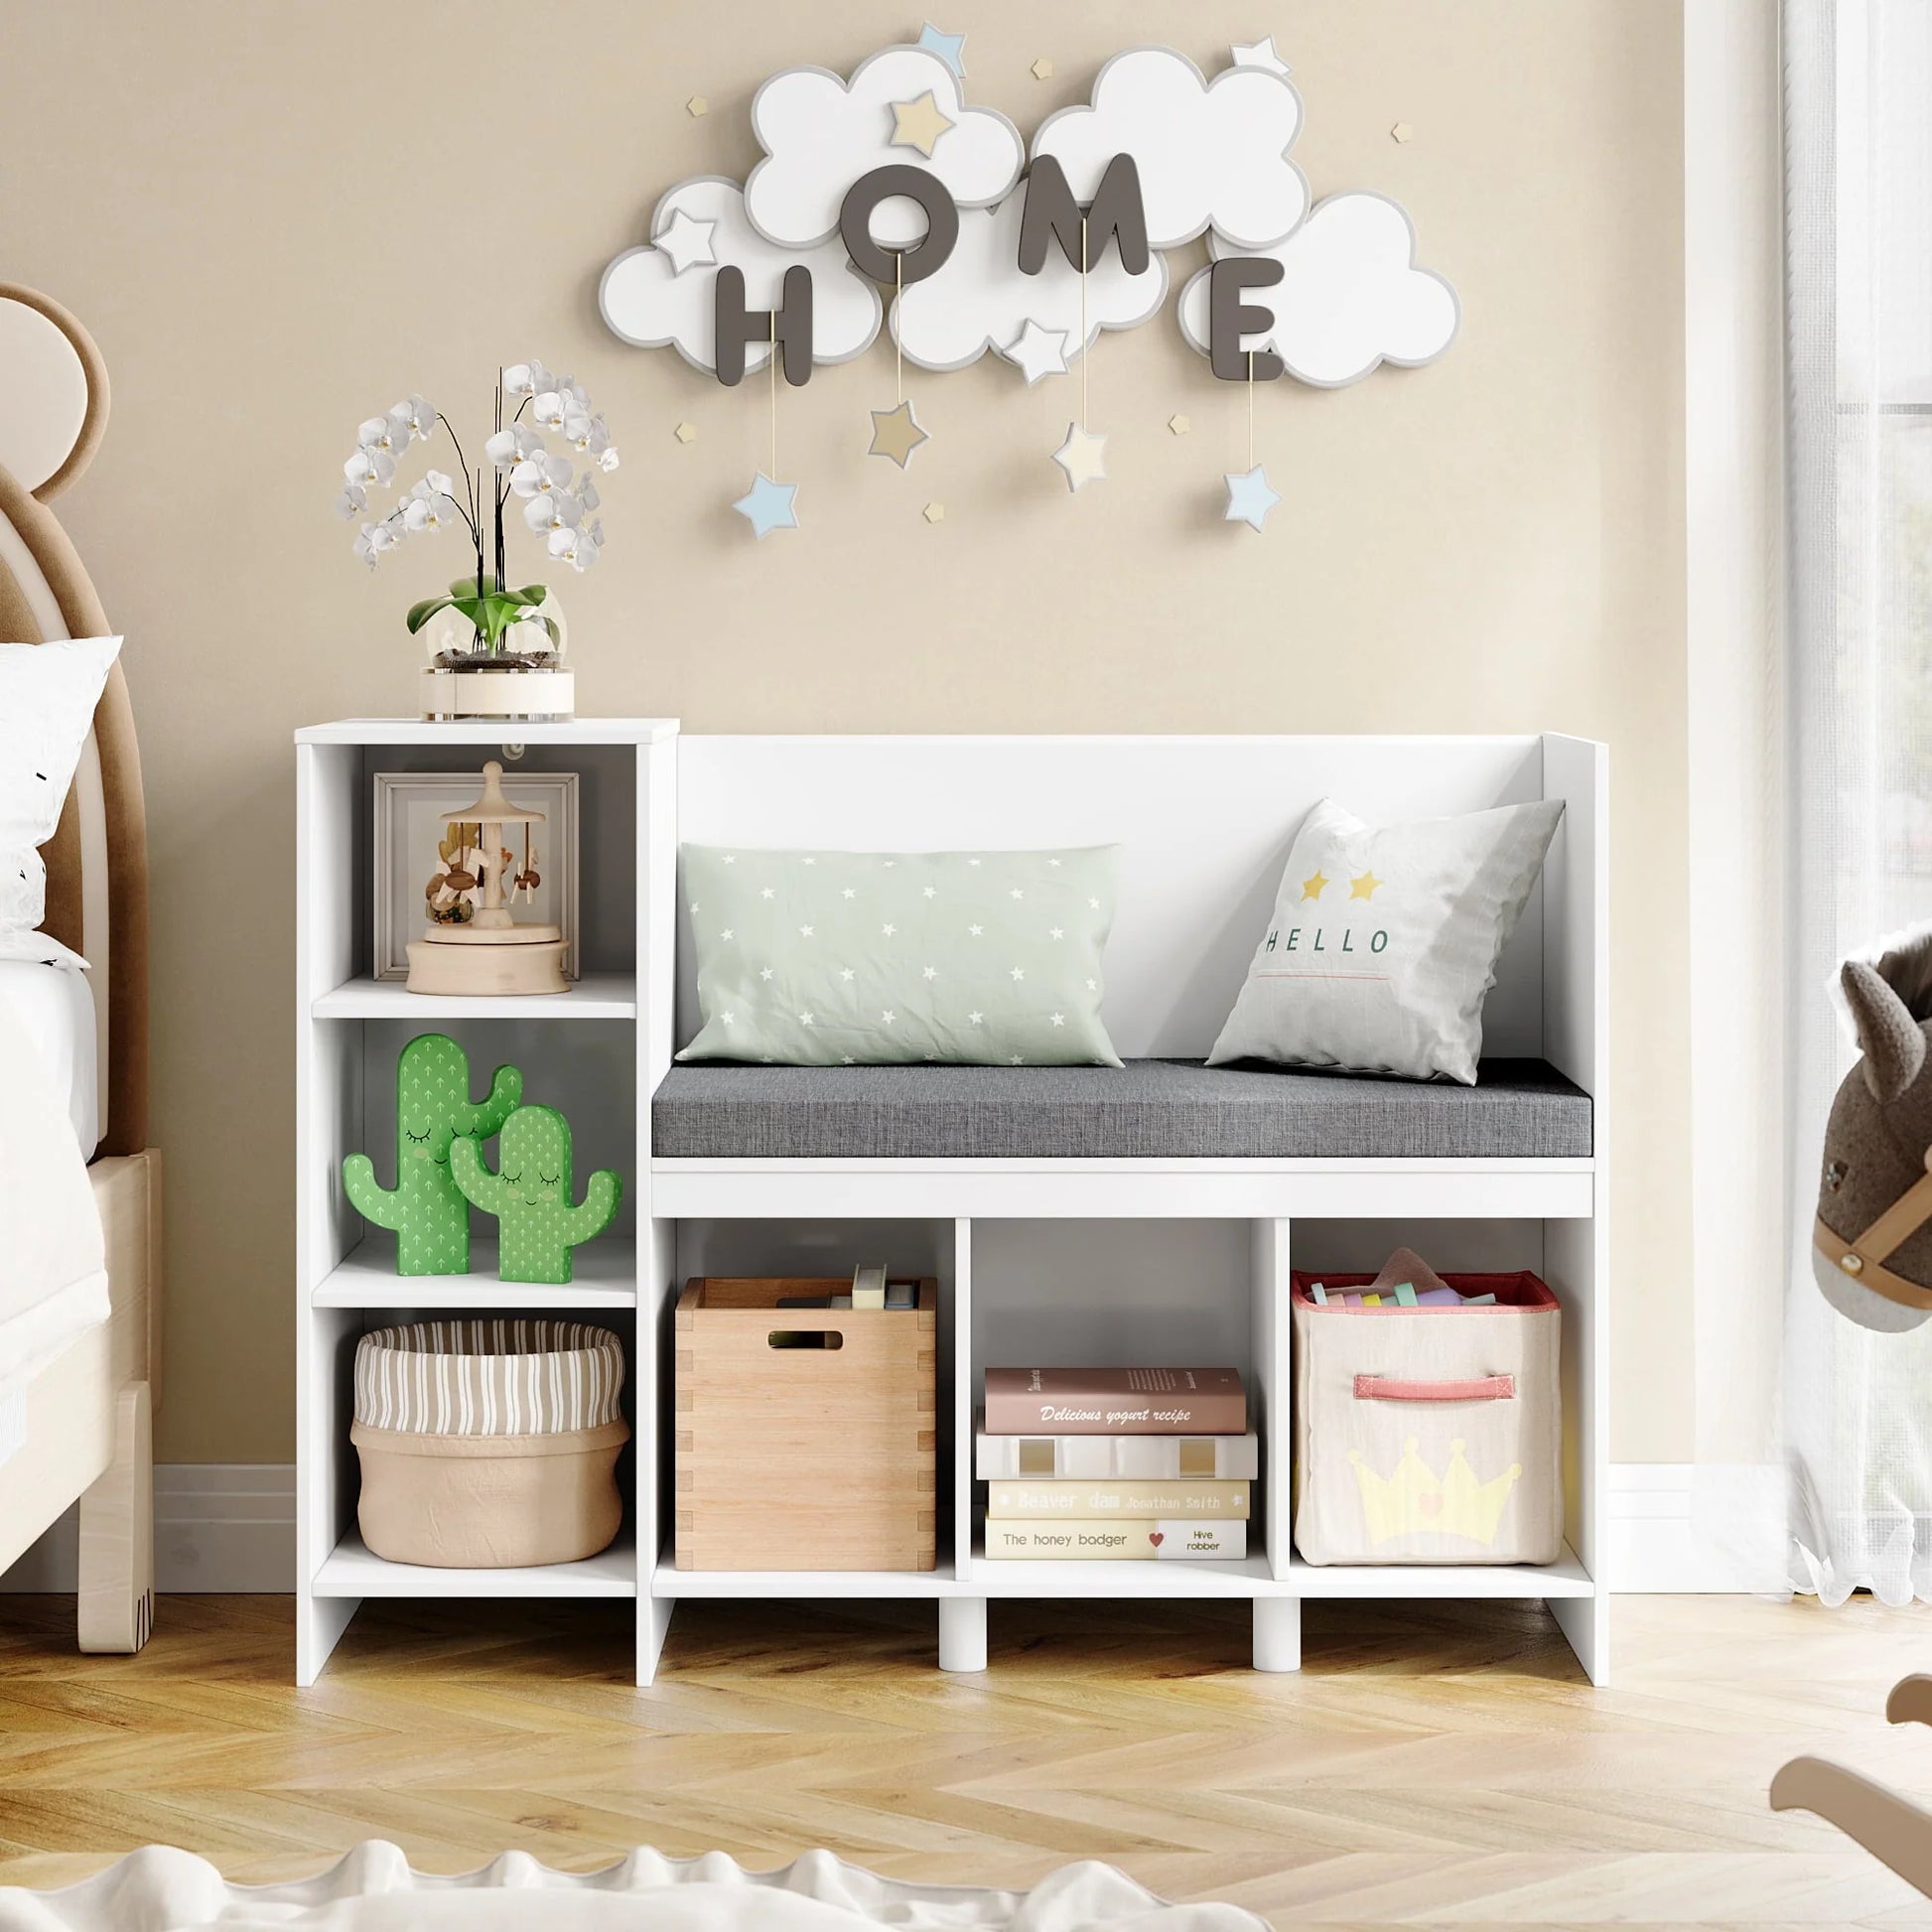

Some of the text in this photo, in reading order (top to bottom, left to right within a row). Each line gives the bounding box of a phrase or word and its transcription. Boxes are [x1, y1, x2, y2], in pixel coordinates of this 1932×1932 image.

[715, 152, 1286, 387] HOME
[1265, 928, 1388, 953] HELLO
[1039, 1405, 1191, 1426] Delicious yogurt recipe
[1089, 1491, 1120, 1509] dam
[1125, 1496, 1220, 1509] Jonathan Smith
[1003, 1533, 1128, 1548] The honey badger
[1193, 1531, 1213, 1540] Hive
[1186, 1542, 1220, 1551] robber
